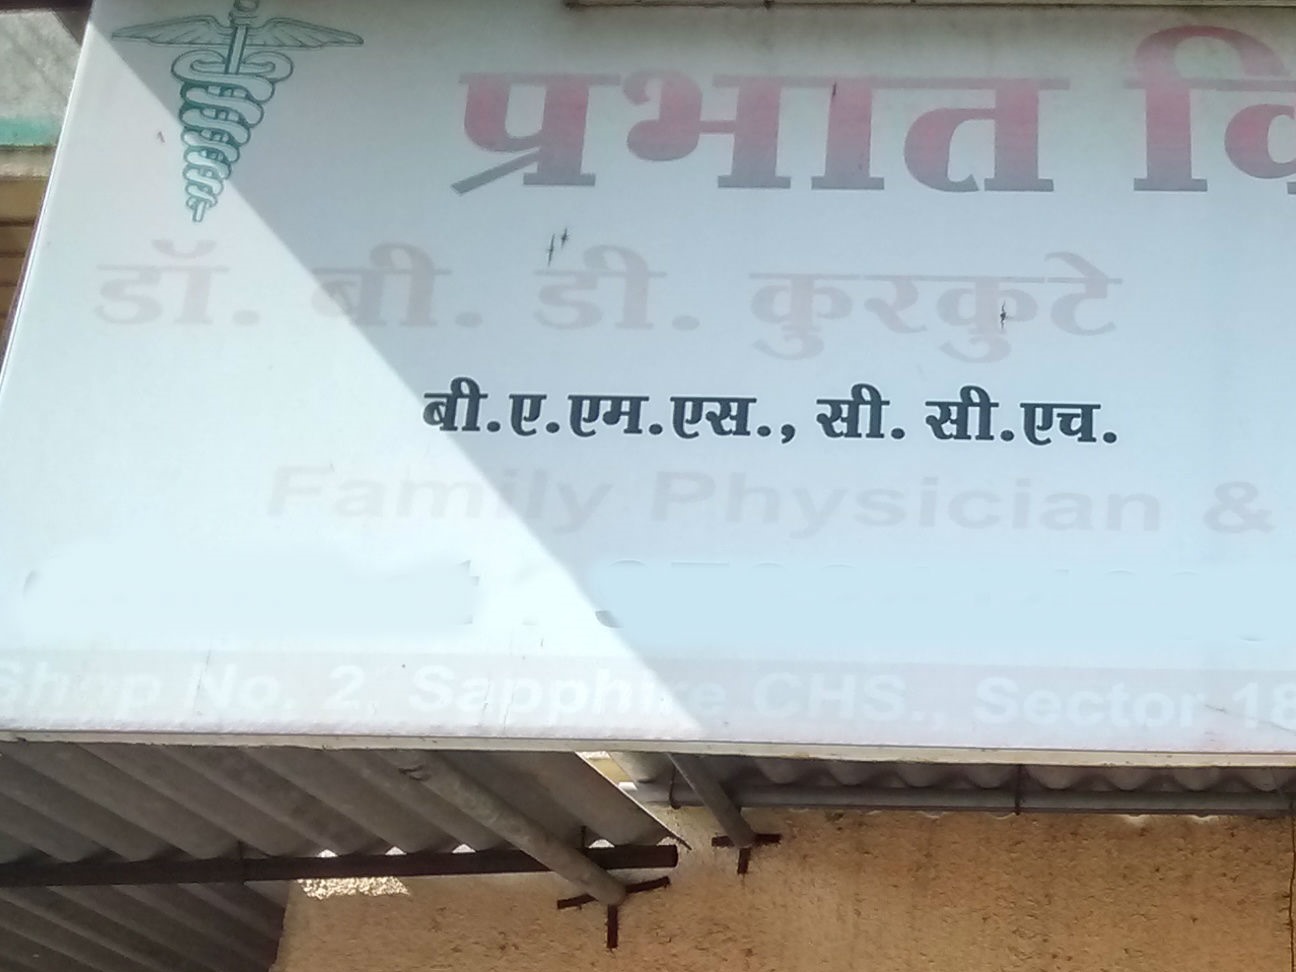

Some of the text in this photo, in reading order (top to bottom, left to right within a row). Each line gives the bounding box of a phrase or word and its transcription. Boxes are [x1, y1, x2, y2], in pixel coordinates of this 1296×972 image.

[451, 68, 1070, 195] प्रभात
[94, 238, 1124, 364] डॉ. बी. डी. कुरकुटे
[422, 376, 796, 443] बी.ए.एम.एस.,
[924, 388, 1118, 446] सी.एच.
[266, 464, 614, 535] Family
[650, 470, 1161, 538] Physician
[1203, 480, 1276, 534] &
[409, 664, 727, 725] Sapphire
[975, 676, 1206, 730] Sector
